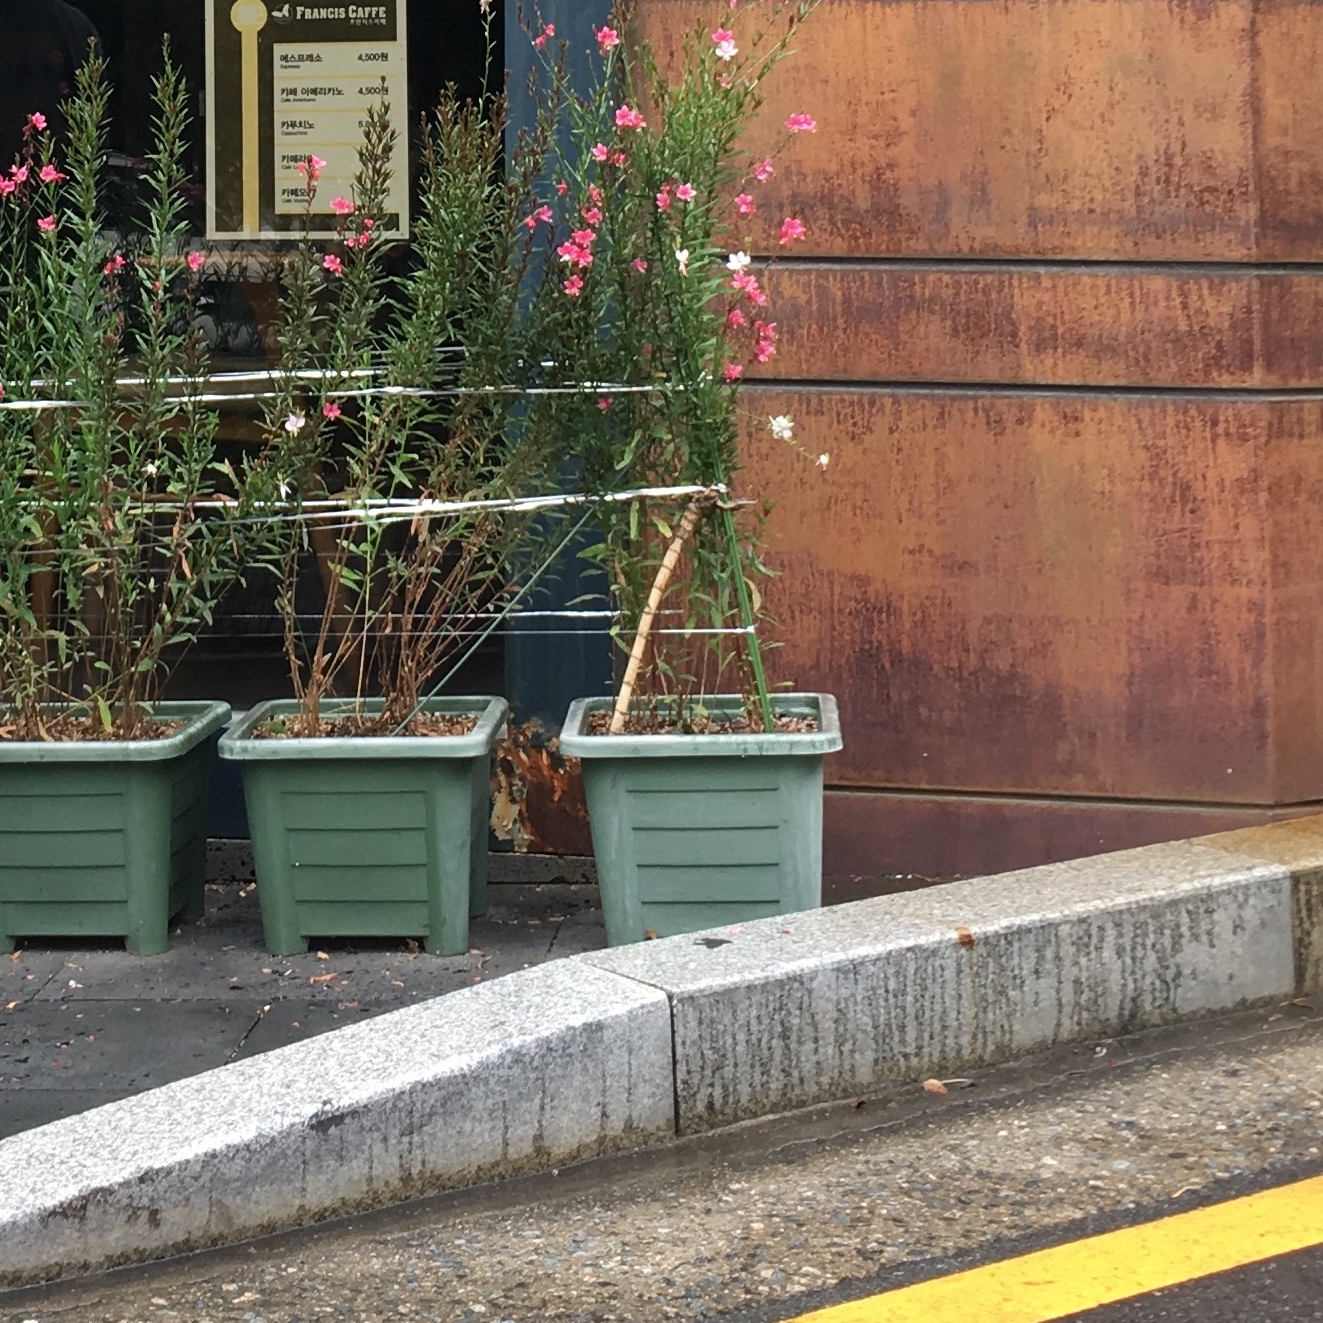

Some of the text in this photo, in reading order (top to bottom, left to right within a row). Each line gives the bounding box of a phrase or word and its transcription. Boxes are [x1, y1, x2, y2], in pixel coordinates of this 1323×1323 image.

[296, 3, 387, 20] FRANCIS CAFFE
[279, 51, 389, 63] 에스프레소 4,500원
[281, 86, 298, 97] 카페
[301, 86, 344, 97] 아메리카노
[281, 119, 315, 130] 카푸치노
